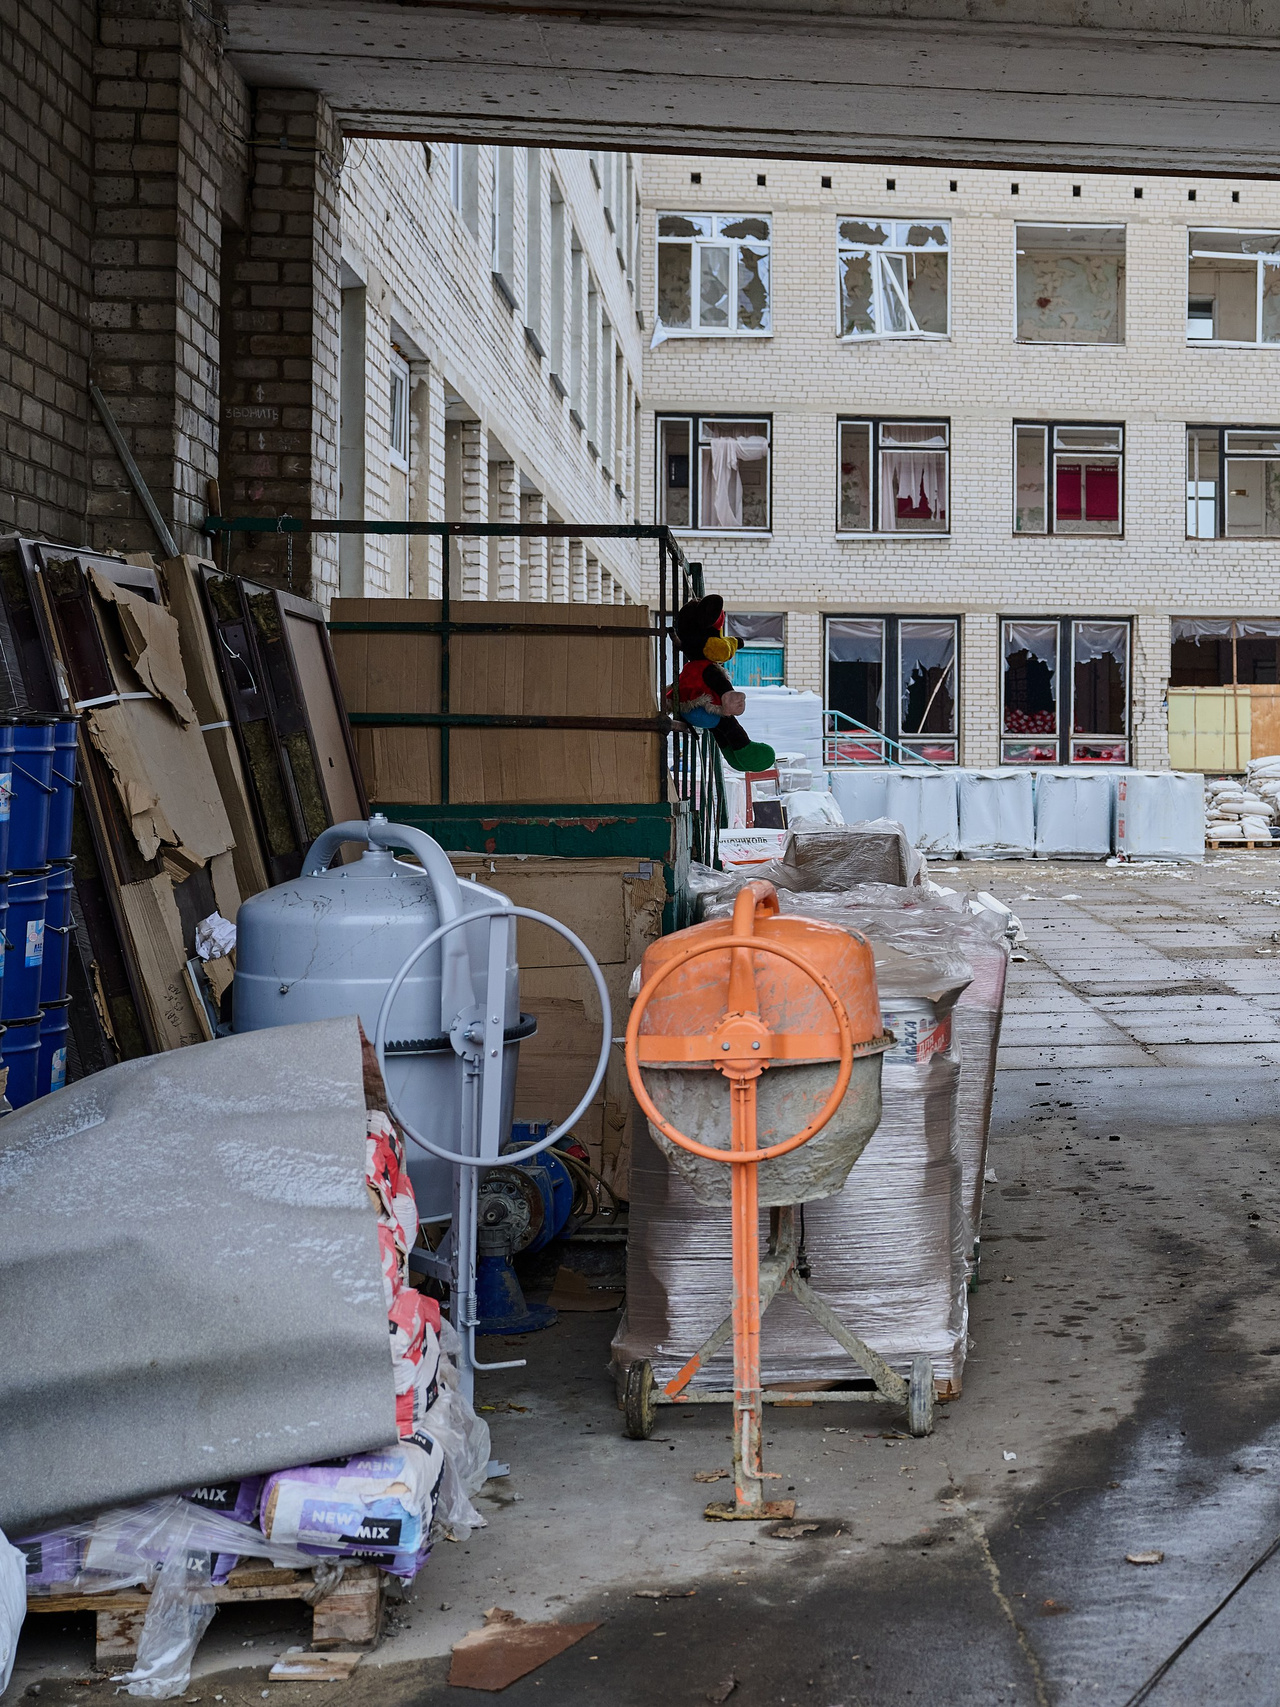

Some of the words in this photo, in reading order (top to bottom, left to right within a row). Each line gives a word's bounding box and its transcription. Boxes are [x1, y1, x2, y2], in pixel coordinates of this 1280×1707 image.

[191, 1487, 228, 1502] MIX
[311, 1510, 354, 1526] NEW
[354, 1525, 391, 1540] MIX
